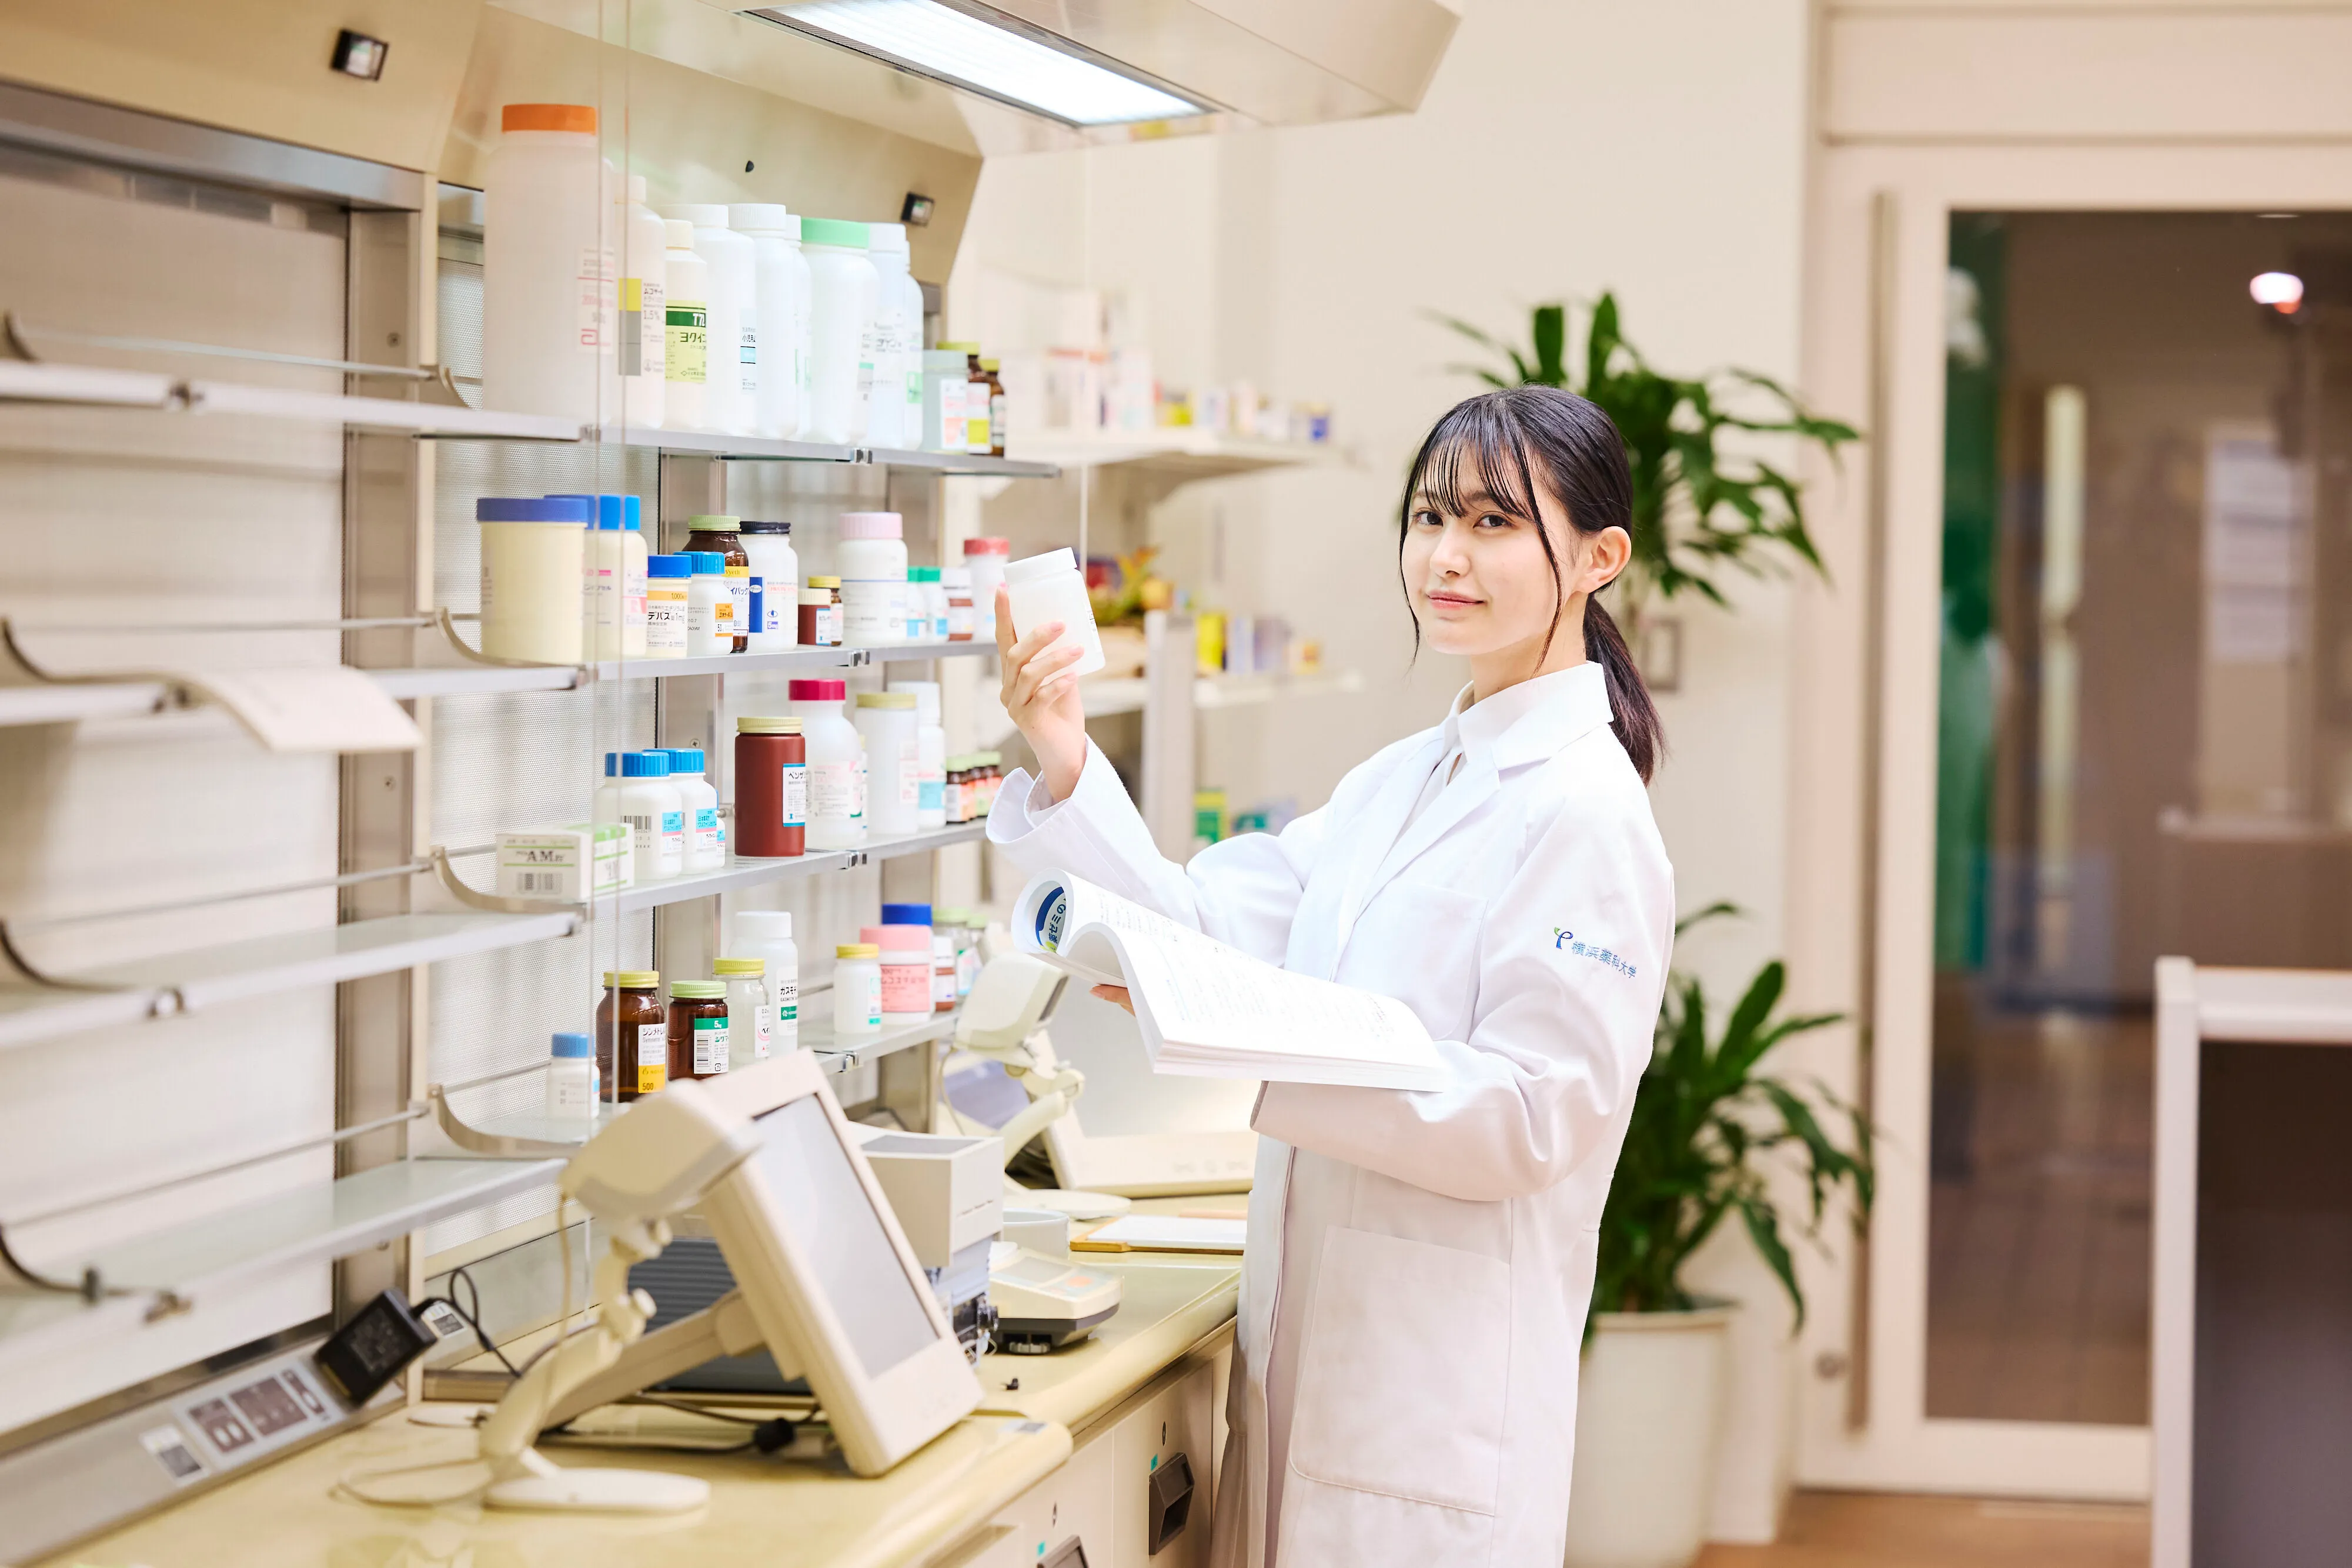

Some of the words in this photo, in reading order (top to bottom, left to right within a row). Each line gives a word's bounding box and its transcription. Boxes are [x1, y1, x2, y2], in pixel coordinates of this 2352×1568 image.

[1048, 898, 1067, 945] 薬ゼミの
[1571, 940, 1638, 978] 横浜薬科大学
